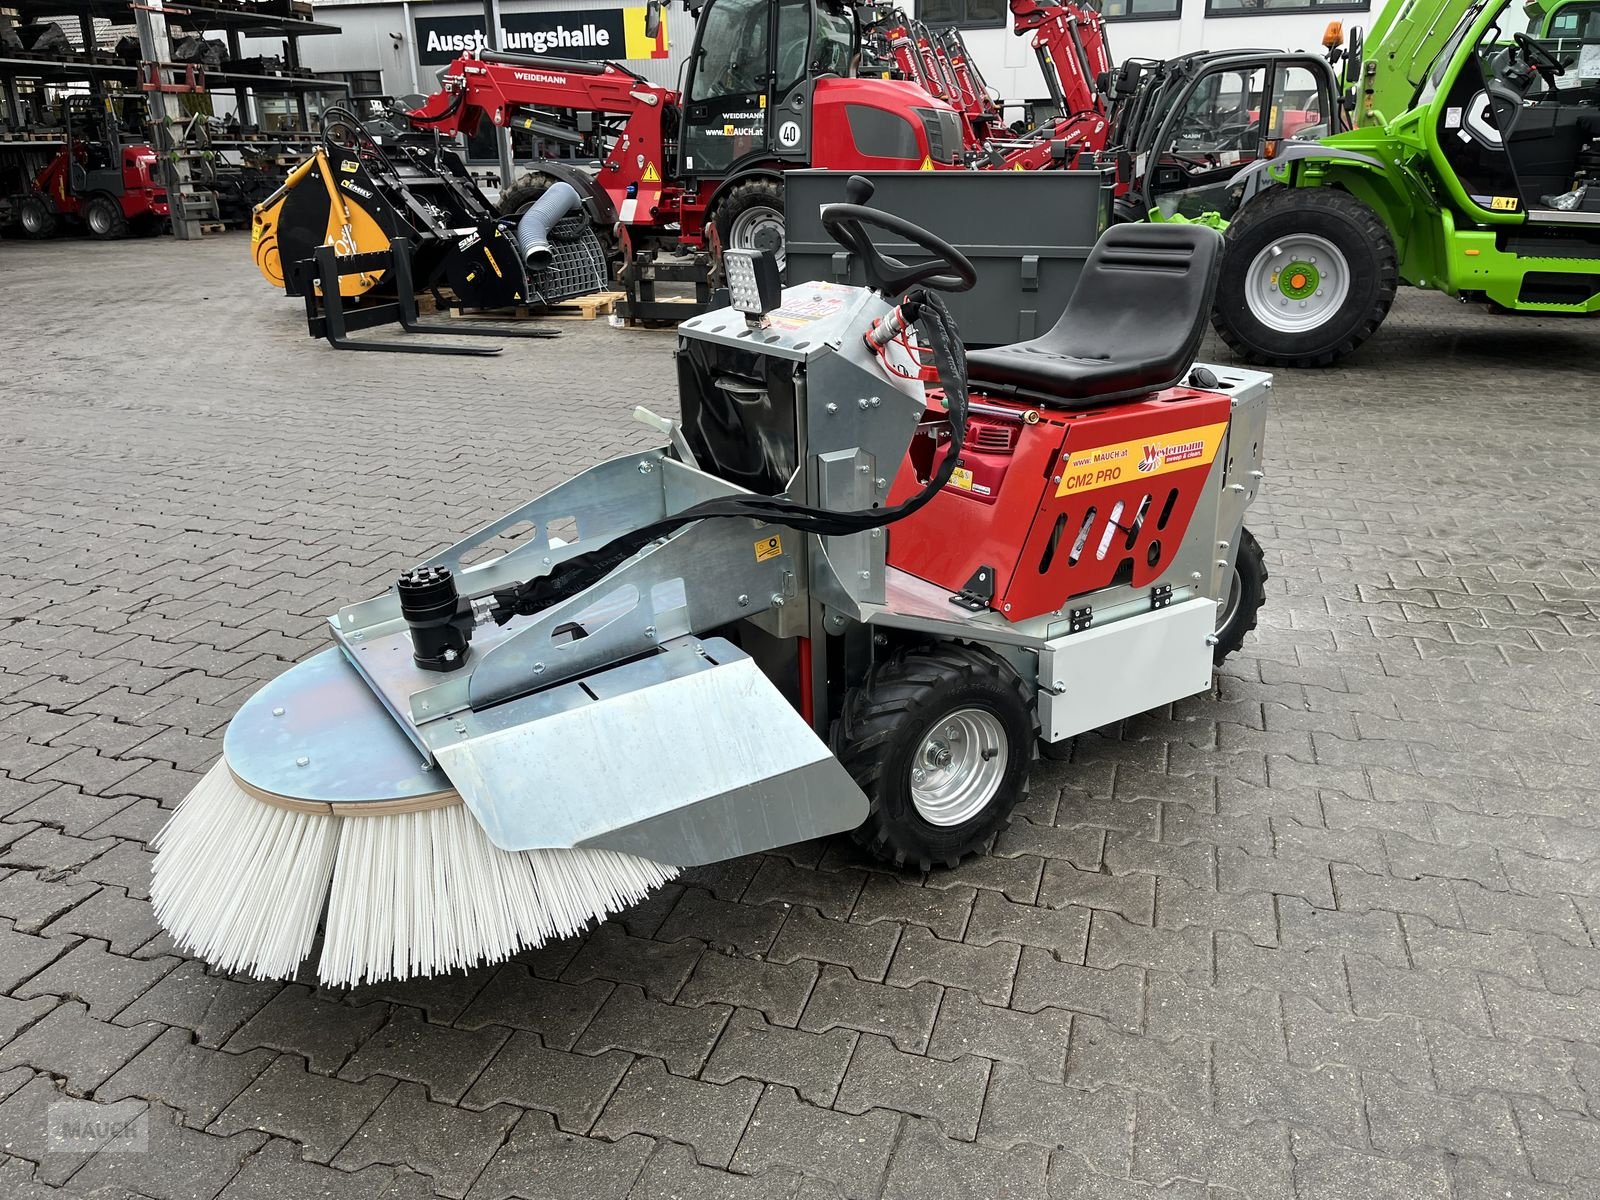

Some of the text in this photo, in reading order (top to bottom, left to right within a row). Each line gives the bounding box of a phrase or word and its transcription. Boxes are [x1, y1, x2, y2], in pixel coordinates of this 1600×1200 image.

[514, 71, 567, 85] WEIDEMANN
[783, 126, 796, 142] 40
[458, 232, 480, 249] SIMA
[1143, 441, 1204, 463] Westermann
[1066, 467, 1122, 490] CM2 PRO
